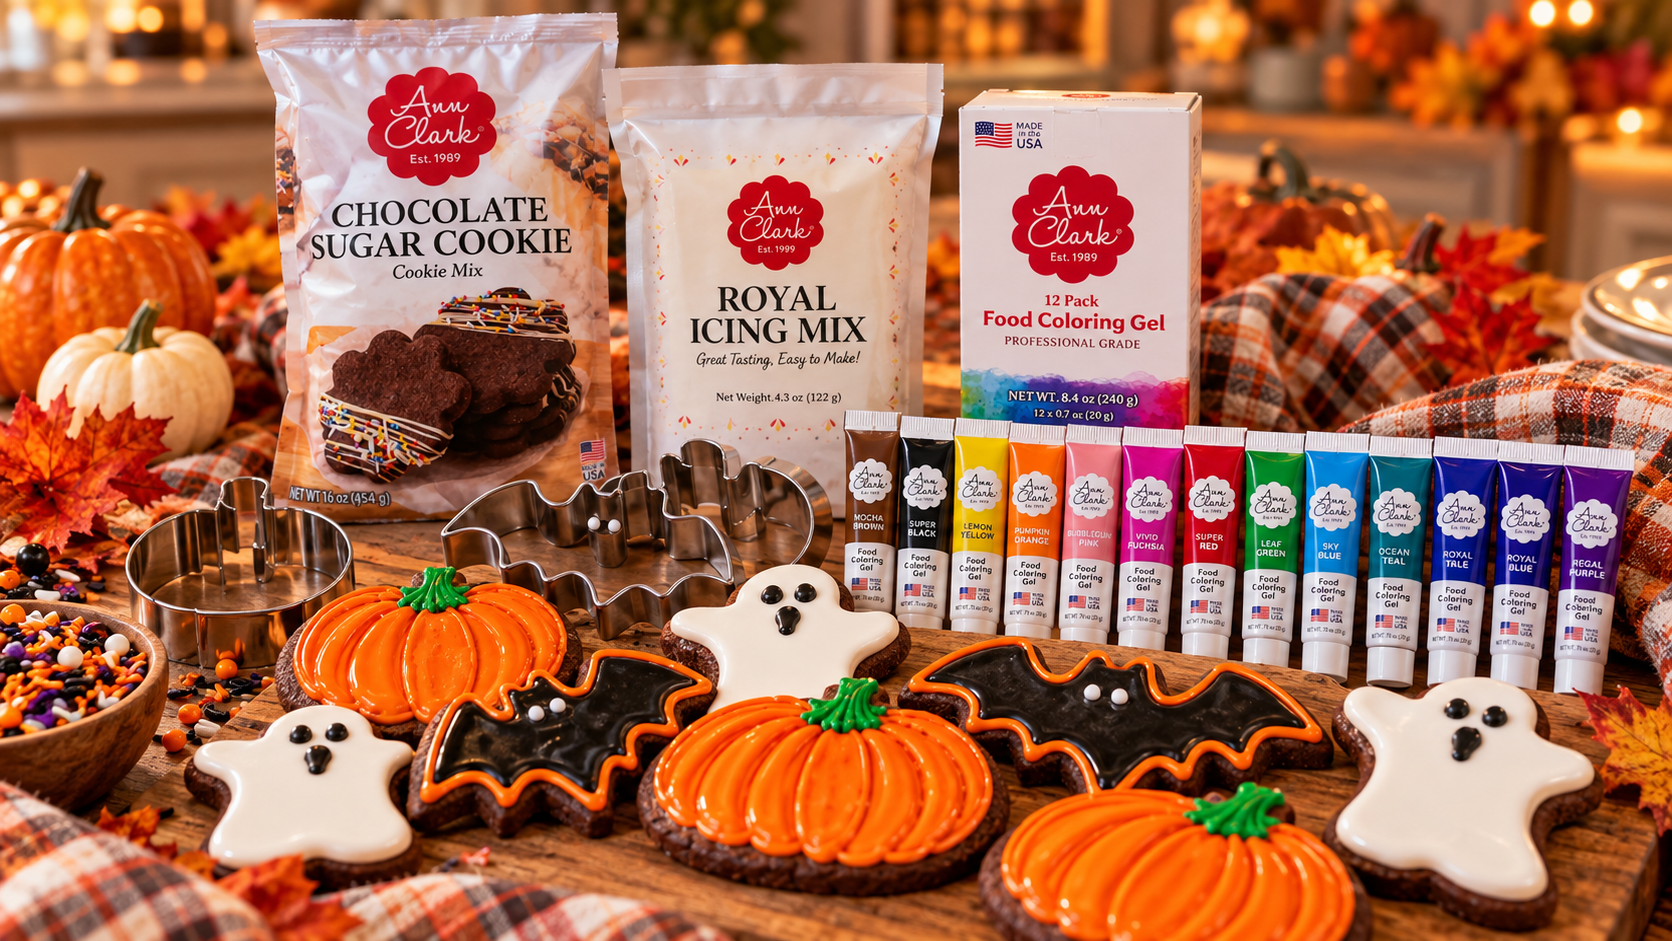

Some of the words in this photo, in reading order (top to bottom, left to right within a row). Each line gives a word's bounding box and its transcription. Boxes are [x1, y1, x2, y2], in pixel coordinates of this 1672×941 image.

[391, 85, 470, 118] Ann
[1016, 122, 1042, 130] MADE
[385, 117, 479, 149] Clark
[1017, 139, 1042, 149] USA
[410, 153, 431, 164] Est.
[434, 152, 461, 164] 1989
[744, 190, 804, 218] Ann
[1033, 186, 1108, 219] Ann
[332, 197, 548, 228] CHOCOLATE
[739, 215, 811, 241] Clark
[1028, 216, 1118, 248] Clark
[311, 231, 425, 260] SUGAR
[433, 228, 572, 256] COOKIE
[758, 245, 773, 254] Est.
[1050, 252, 1070, 262] Est.
[1072, 252, 1097, 262] 1989
[393, 263, 447, 280] Cookie
[451, 263, 483, 277] Mix
[718, 285, 836, 311] ROYAL
[1044, 295, 1060, 307] 12
[1065, 295, 1099, 308] Pack
[983, 310, 1033, 328] Food
[1038, 313, 1125, 334] Coloring
[1130, 314, 1166, 331] Gel
[690, 317, 787, 345] ICING
[798, 316, 867, 343] MIX
[1005, 336, 1095, 348] PROFESSIONAL
[1099, 339, 1141, 349] GRADE
[696, 352, 726, 366] Great
[729, 352, 773, 369] Tasting,
[778, 352, 806, 369] Easy
[809, 354, 820, 365] to
[824, 351, 860, 365] Make!
[716, 392, 733, 402] Net
[792, 394, 803, 402] oz
[806, 392, 828, 404] (122
[832, 393, 841, 404] g)
[1008, 390, 1034, 401] NET
[1036, 392, 1059, 402] WT.
[1062, 393, 1078, 404] 8.4
[1082, 396, 1095, 404] oz
[1098, 394, 1124, 406] (240
[1126, 394, 1138, 407] g)
[1034, 409, 1045, 417] 12
[1056, 410, 1069, 418] 0.7
[1085, 410, 1101, 420] (20
[1104, 412, 1114, 422] g)
[583, 470, 605, 481] USA
[289, 486, 304, 500] NET
[305, 489, 320, 502] WT
[322, 491, 333, 503] 16
[336, 494, 348, 503] oz
[351, 492, 375, 506] (454
[379, 492, 390, 506] g)
[853, 522, 884, 530] BROWN
[909, 520, 936, 528] SUPER
[963, 523, 992, 531] LEMON
[908, 529, 936, 537] BLACK
[961, 531, 994, 540] YELLOW
[1015, 527, 1050, 535] PUMPKIN
[1014, 536, 1049, 545] ORANGE
[1196, 533, 1223, 541] SUPER
[1128, 542, 1164, 551] FUCHSIA
[1200, 542, 1218, 550] RED
[1257, 549, 1286, 557] GREEN
[1318, 551, 1341, 560] BLUE
[1379, 548, 1410, 556] OCEAN
[1507, 555, 1537, 563] ROYAL
[1077, 565, 1096, 573] Food
[1509, 564, 1533, 573] BLUE
[1573, 560, 1603, 569] REGAL
[1569, 569, 1605, 579] PURPLE
[1319, 578, 1338, 586] Food
[1446, 587, 1466, 595] Food
[1509, 590, 1530, 598] Food
